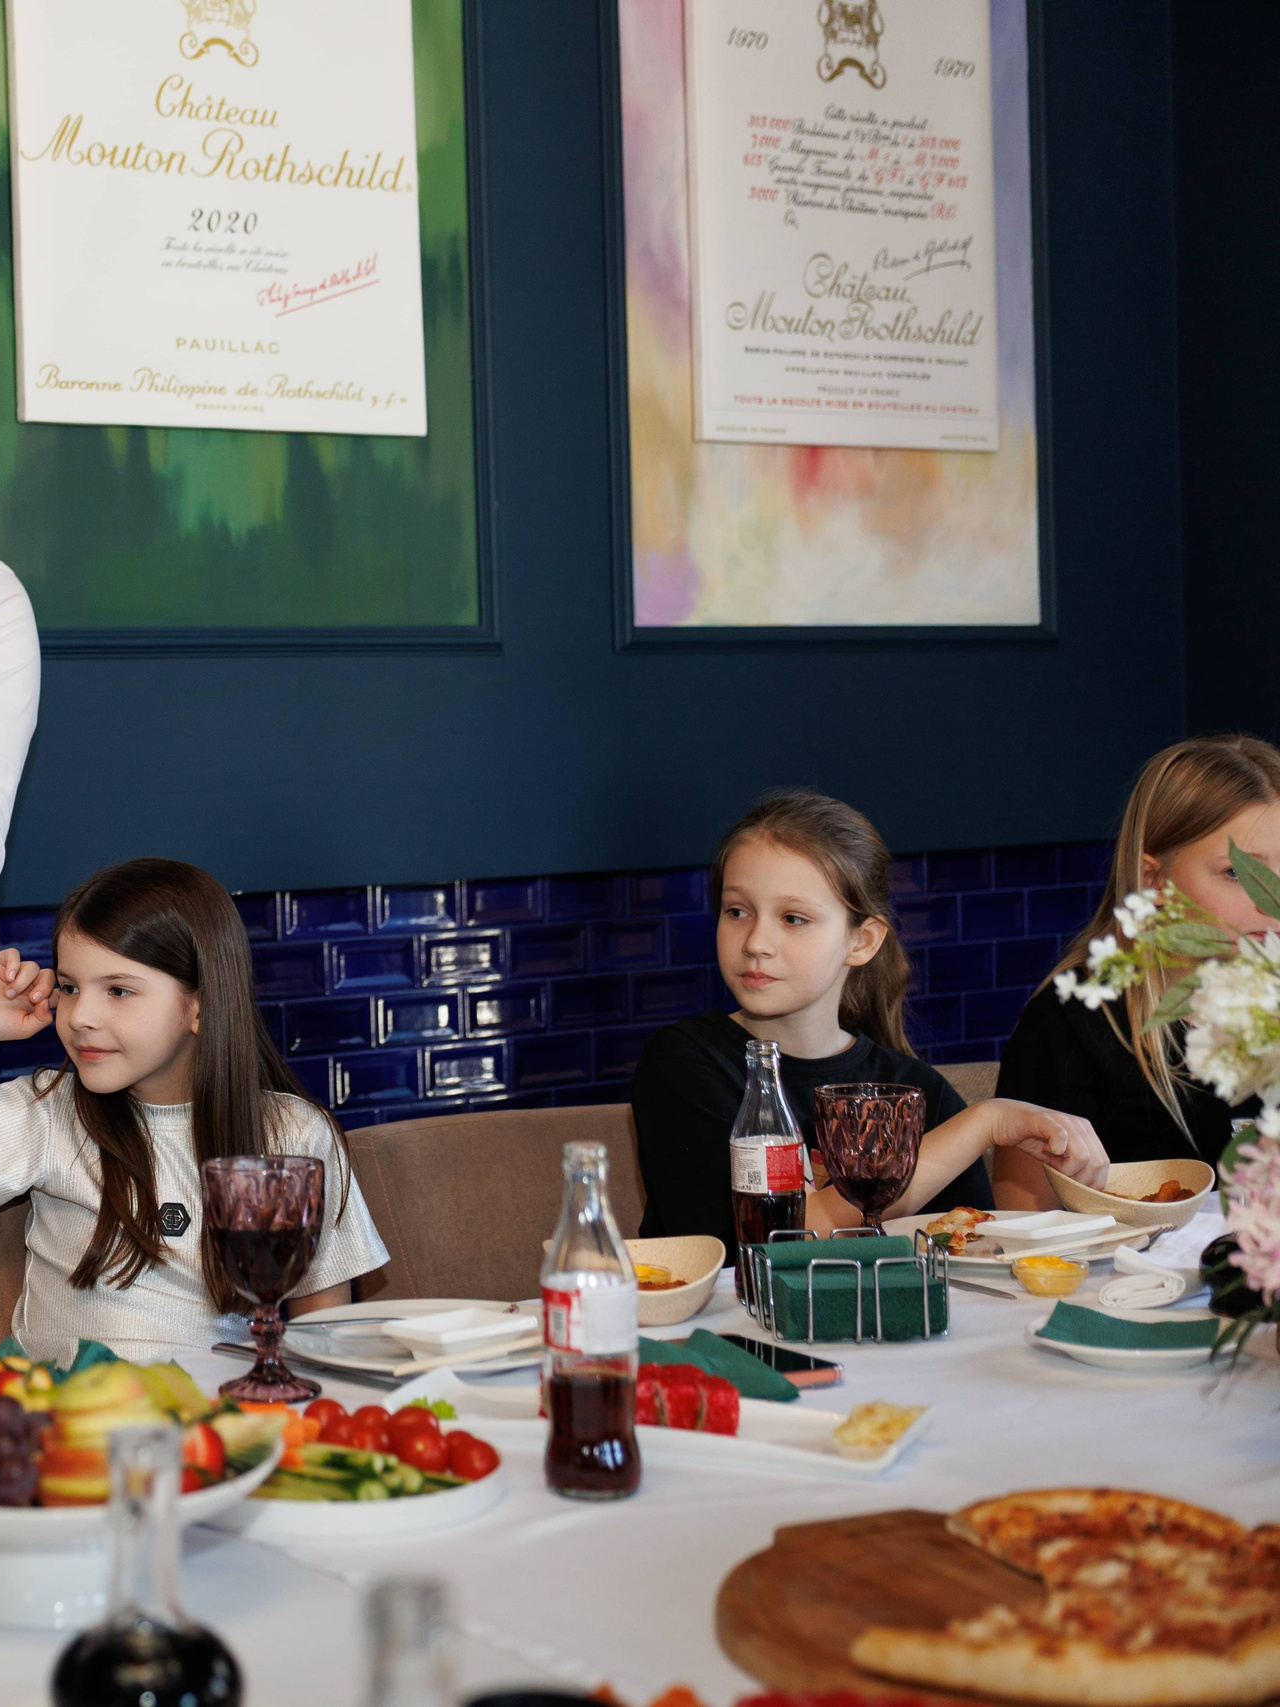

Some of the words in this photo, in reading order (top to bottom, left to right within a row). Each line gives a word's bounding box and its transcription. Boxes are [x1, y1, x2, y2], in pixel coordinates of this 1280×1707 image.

[726, 26, 769, 51] 1970
[933, 56, 976, 80] 1970
[155, 74, 279, 128] Château
[19, 114, 186, 176] Mouton
[191, 128, 407, 193] Rothschild
[187, 207, 258, 235] 2020
[725, 289, 836, 342] Mouton
[838, 299, 984, 346] Rothschild
[176, 337, 281, 354] PAUILLAC
[35, 363, 122, 391] Baronne
[129, 367, 227, 400] Philippine
[236, 381, 259, 397] de
[265, 373, 363, 402] Rothschild
